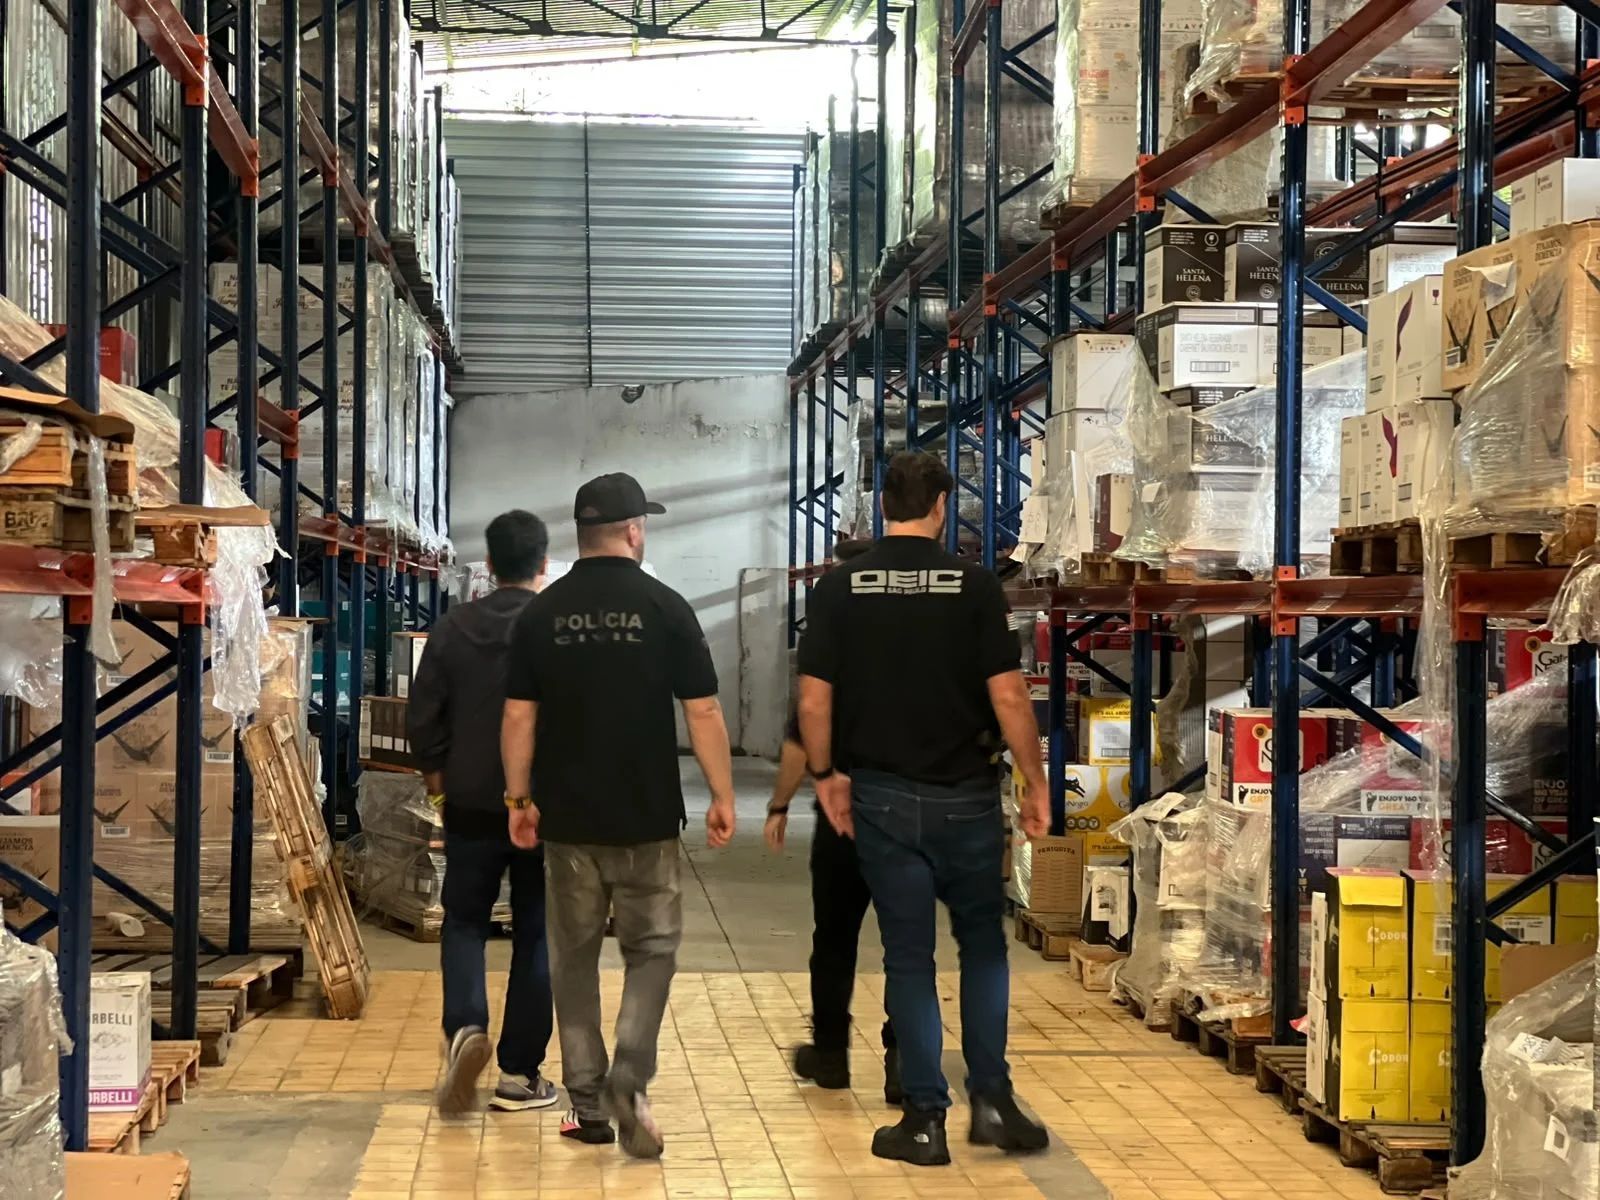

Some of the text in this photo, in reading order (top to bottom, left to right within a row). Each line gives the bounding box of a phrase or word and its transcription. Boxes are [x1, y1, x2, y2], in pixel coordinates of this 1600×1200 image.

[1176, 274, 1211, 282] HELENA
[1249, 272, 1279, 280] HELEN
[1326, 282, 1364, 291] HELENA
[1534, 780, 1567, 789] ENJO
